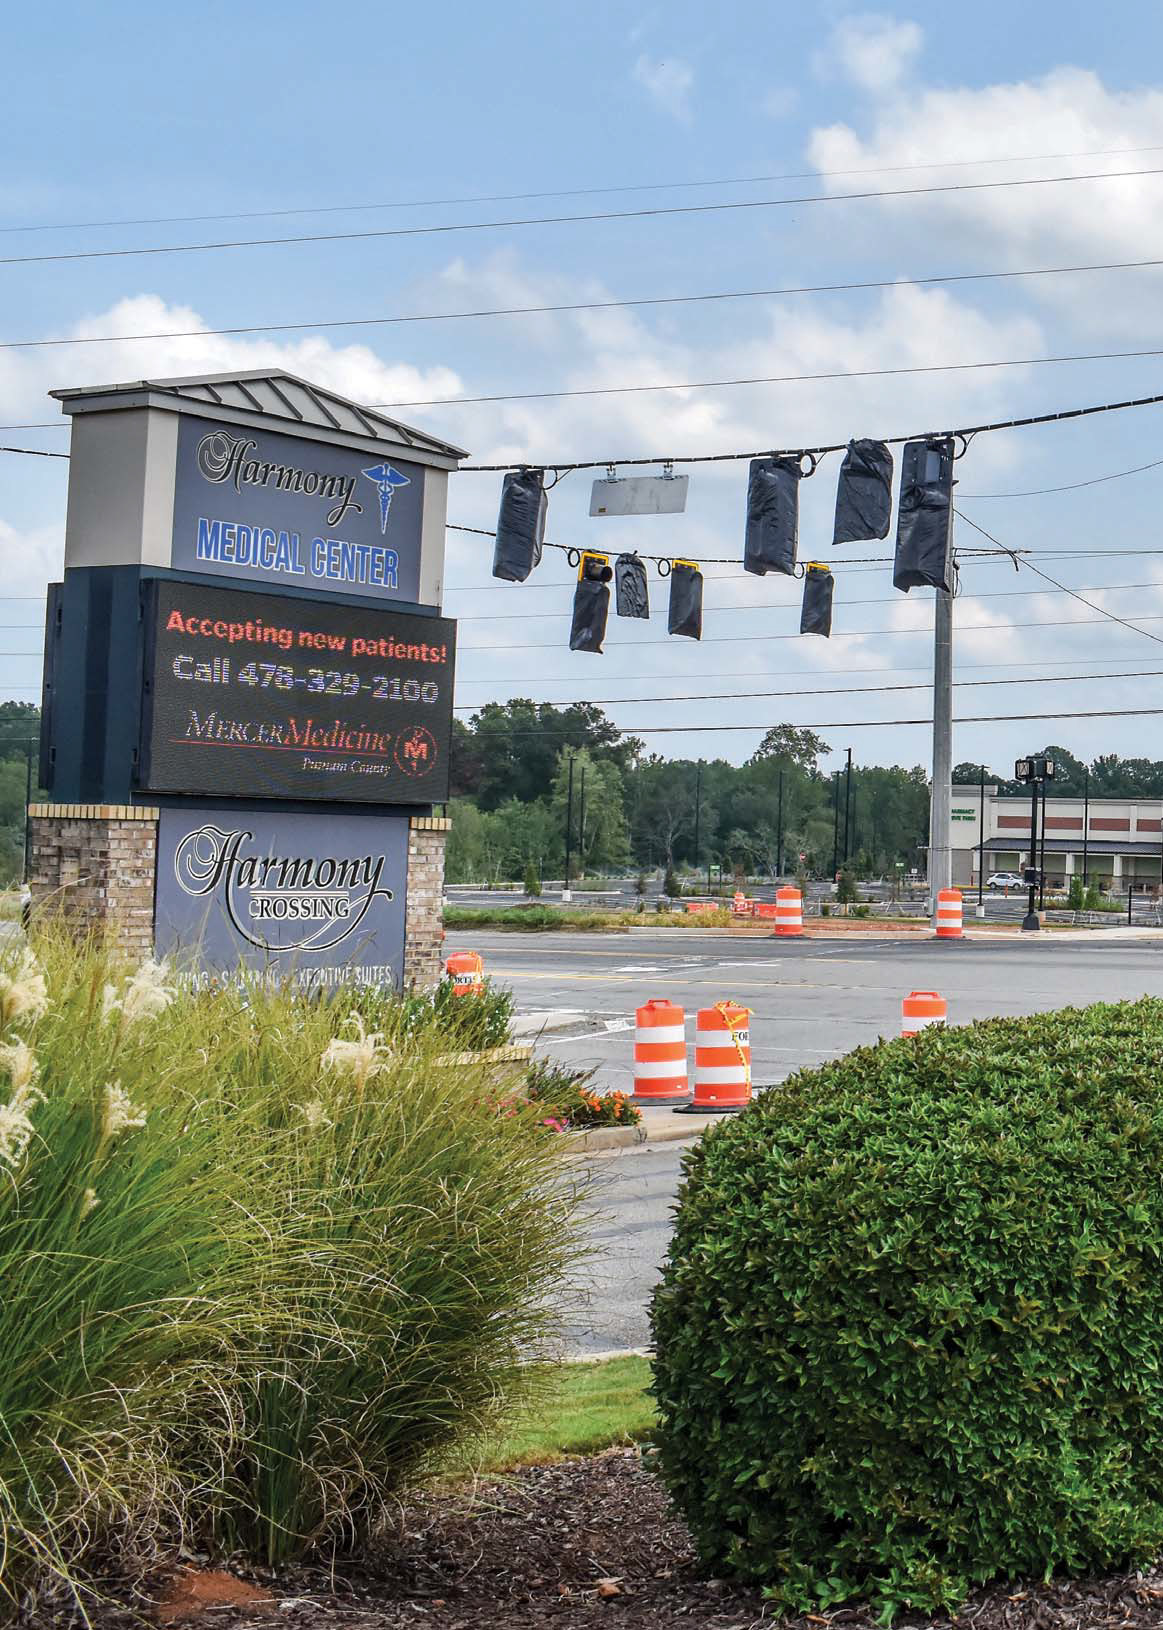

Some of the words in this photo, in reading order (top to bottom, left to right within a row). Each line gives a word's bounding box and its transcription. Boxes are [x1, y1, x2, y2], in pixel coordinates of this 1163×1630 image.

[196, 430, 364, 528] Harmony
[196, 517, 306, 576] MEDICAL
[310, 537, 399, 589] CENTER
[166, 610, 293, 649] Accepting
[298, 630, 346, 650] new
[351, 636, 448, 663] patients!
[172, 655, 231, 684] Call
[237, 662, 440, 703] 478-329-2100
[175, 824, 393, 951] Harmony
[249, 898, 350, 920] CROSSING
[294, 966, 353, 987] XECUTIVE
